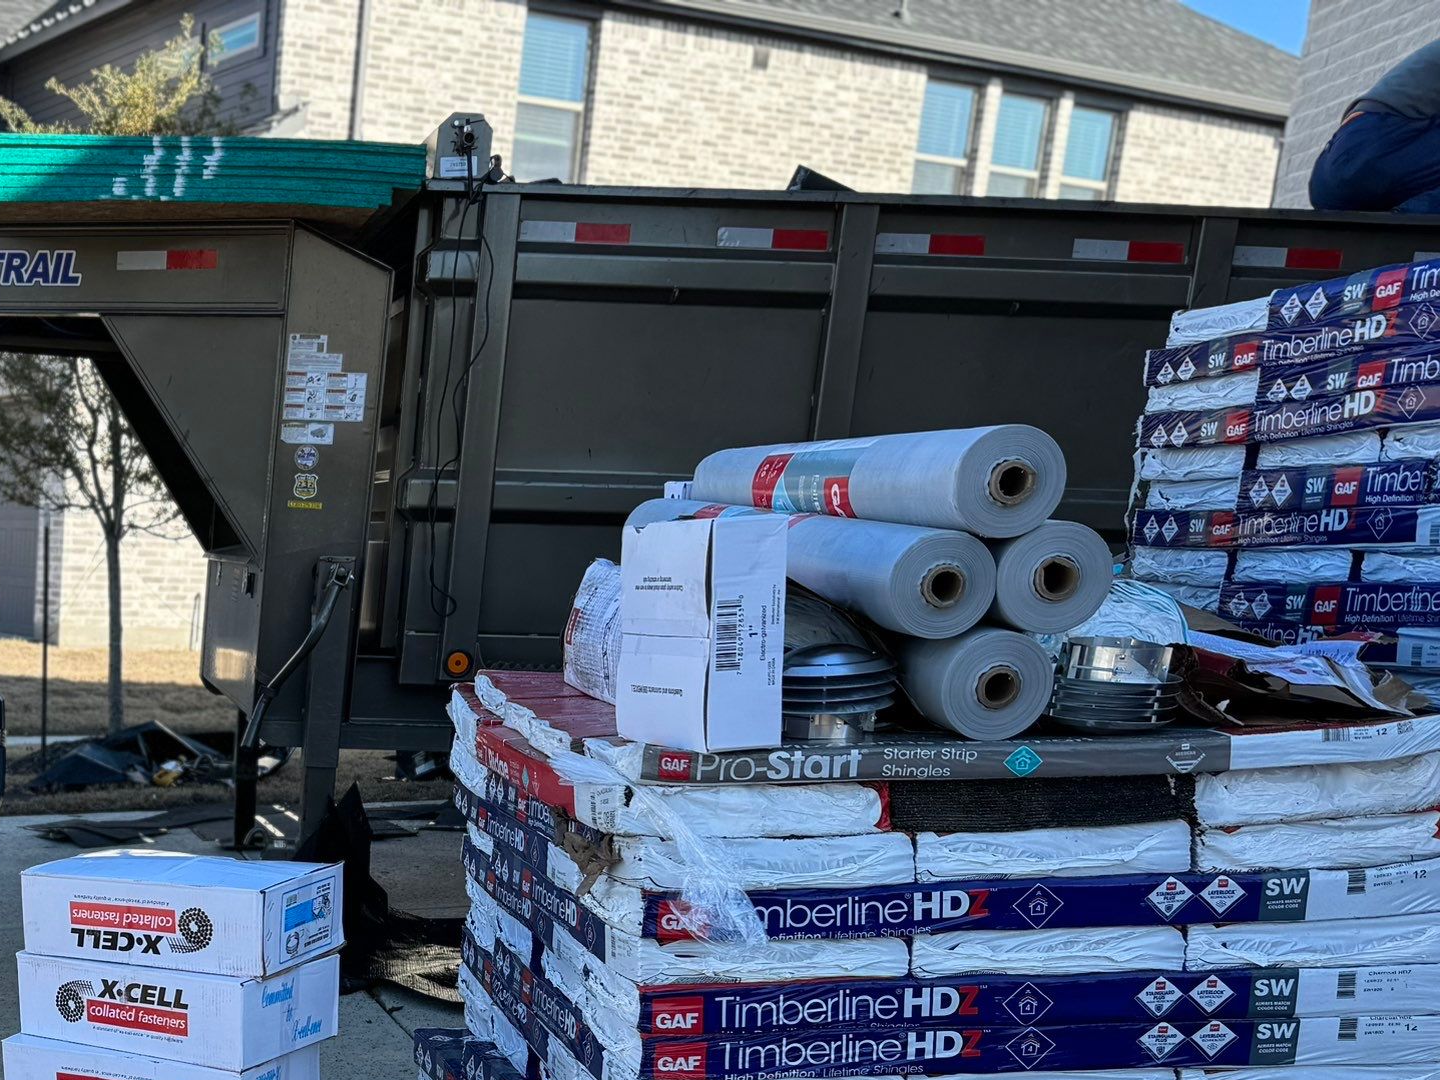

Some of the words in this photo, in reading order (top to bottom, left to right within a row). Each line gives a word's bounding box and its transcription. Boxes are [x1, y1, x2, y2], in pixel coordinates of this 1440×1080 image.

[1343, 283, 1366, 300] SW
[1375, 282, 1402, 298] GAF
[1208, 352, 1228, 369] SW
[1234, 352, 1255, 366] GAF
[1262, 327, 1354, 361] Timberline
[1326, 372, 1348, 390] SW
[1357, 373, 1382, 388] GAF
[1200, 421, 1218, 437] SW
[1226, 424, 1247, 438] GAF
[1253, 402, 1343, 434] Timberline
[1305, 476, 1325, 494] SW
[1334, 481, 1358, 496] GAF
[1189, 518, 1205, 533] SW
[1212, 523, 1232, 535] GAF
[1238, 512, 1319, 535] Timberline
[1285, 594, 1305, 609] SW
[1314, 600, 1338, 613] GAF
[1376, 728, 1388, 736] 12
[883, 746, 938, 761] Starter
[941, 747, 978, 764] Strip
[661, 756, 689, 772] GAF
[697, 749, 863, 781] Pro-Start
[882, 763, 951, 779] Shingles
[1413, 869, 1427, 879] 12
[1265, 878, 1306, 896] SW
[532, 876, 565, 921] Timberline
[72, 908, 120, 925] fasteners
[123, 912, 173, 930] collated
[1254, 979, 1294, 997] SW
[89, 1004, 136, 1022] collated
[138, 1010, 186, 1029] fasteners
[655, 1012, 699, 1029] GAF
[715, 988, 898, 1029] Timberline
[1256, 1022, 1297, 1040] SW
[1404, 1023, 1418, 1032] 12
[657, 1055, 702, 1072] GAF
[718, 1033, 902, 1071] Timberline
[758, 1070, 817, 1080] Definition
[873, 1063, 923, 1077] Shingles
